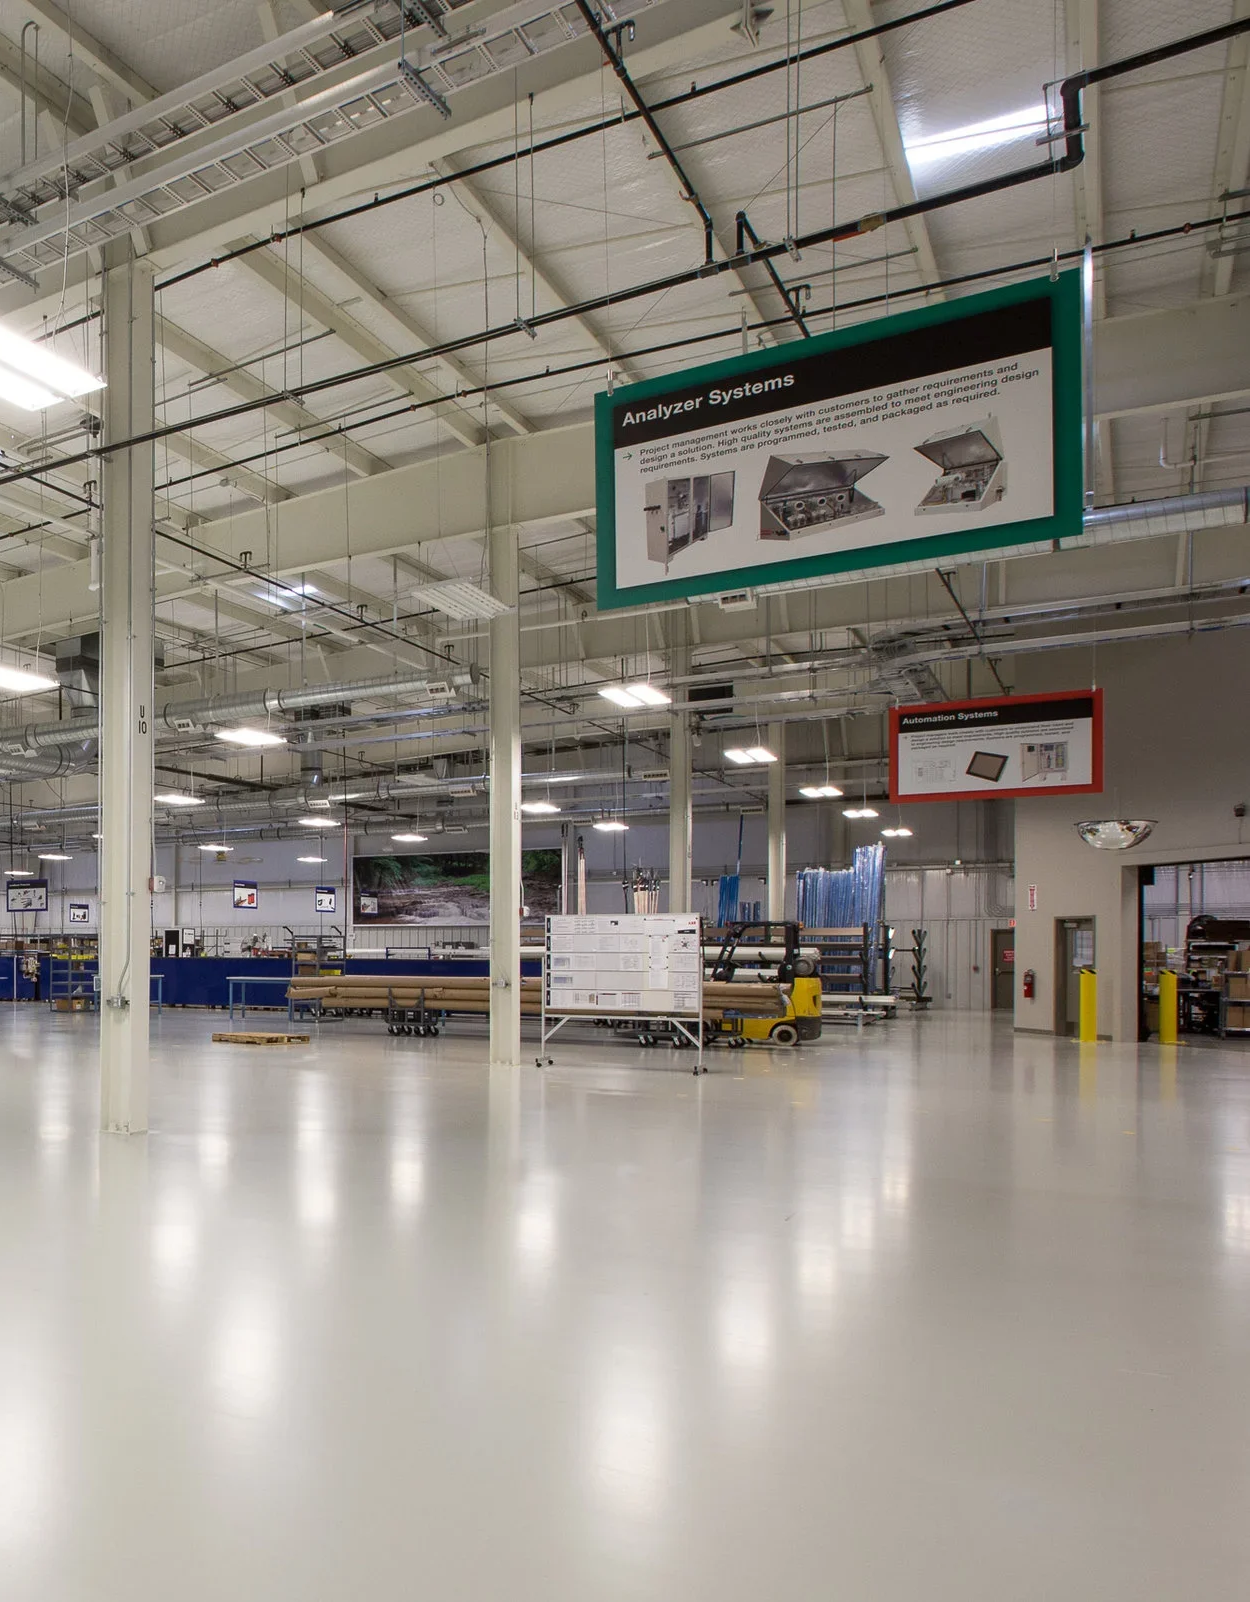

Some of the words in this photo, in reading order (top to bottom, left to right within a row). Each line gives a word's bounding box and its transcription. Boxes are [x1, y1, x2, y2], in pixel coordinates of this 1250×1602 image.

[622, 396, 703, 427] Analyzer
[708, 374, 795, 405] Systems
[640, 444, 670, 456] Project
[672, 430, 728, 449] management
[731, 421, 757, 435] works
[760, 415, 793, 428] closely
[795, 410, 815, 420] with
[818, 397, 870, 415] customers
[886, 386, 920, 400] gather
[923, 370, 993, 391] requirements
[997, 362, 1018, 374] and
[640, 453, 669, 465] design
[678, 444, 714, 456] solution.
[718, 437, 738, 448] High
[741, 430, 772, 443] quality
[774, 421, 812, 435] systems
[816, 417, 831, 425] are
[834, 403, 888, 421] assembled
[904, 394, 931, 404] meet
[934, 379, 998, 399] engineering
[1001, 369, 1039, 384] design
[640, 457, 698, 473] requirements.
[700, 448, 737, 461] Systems
[758, 429, 820, 446] programmed,
[823, 421, 857, 432] tested,
[860, 414, 879, 425] and
[882, 403, 933, 421] packaged
[952, 388, 1000, 404] required.
[139, 705, 145, 718] U
[902, 714, 956, 725] Automation
[957, 710, 999, 721] Systems
